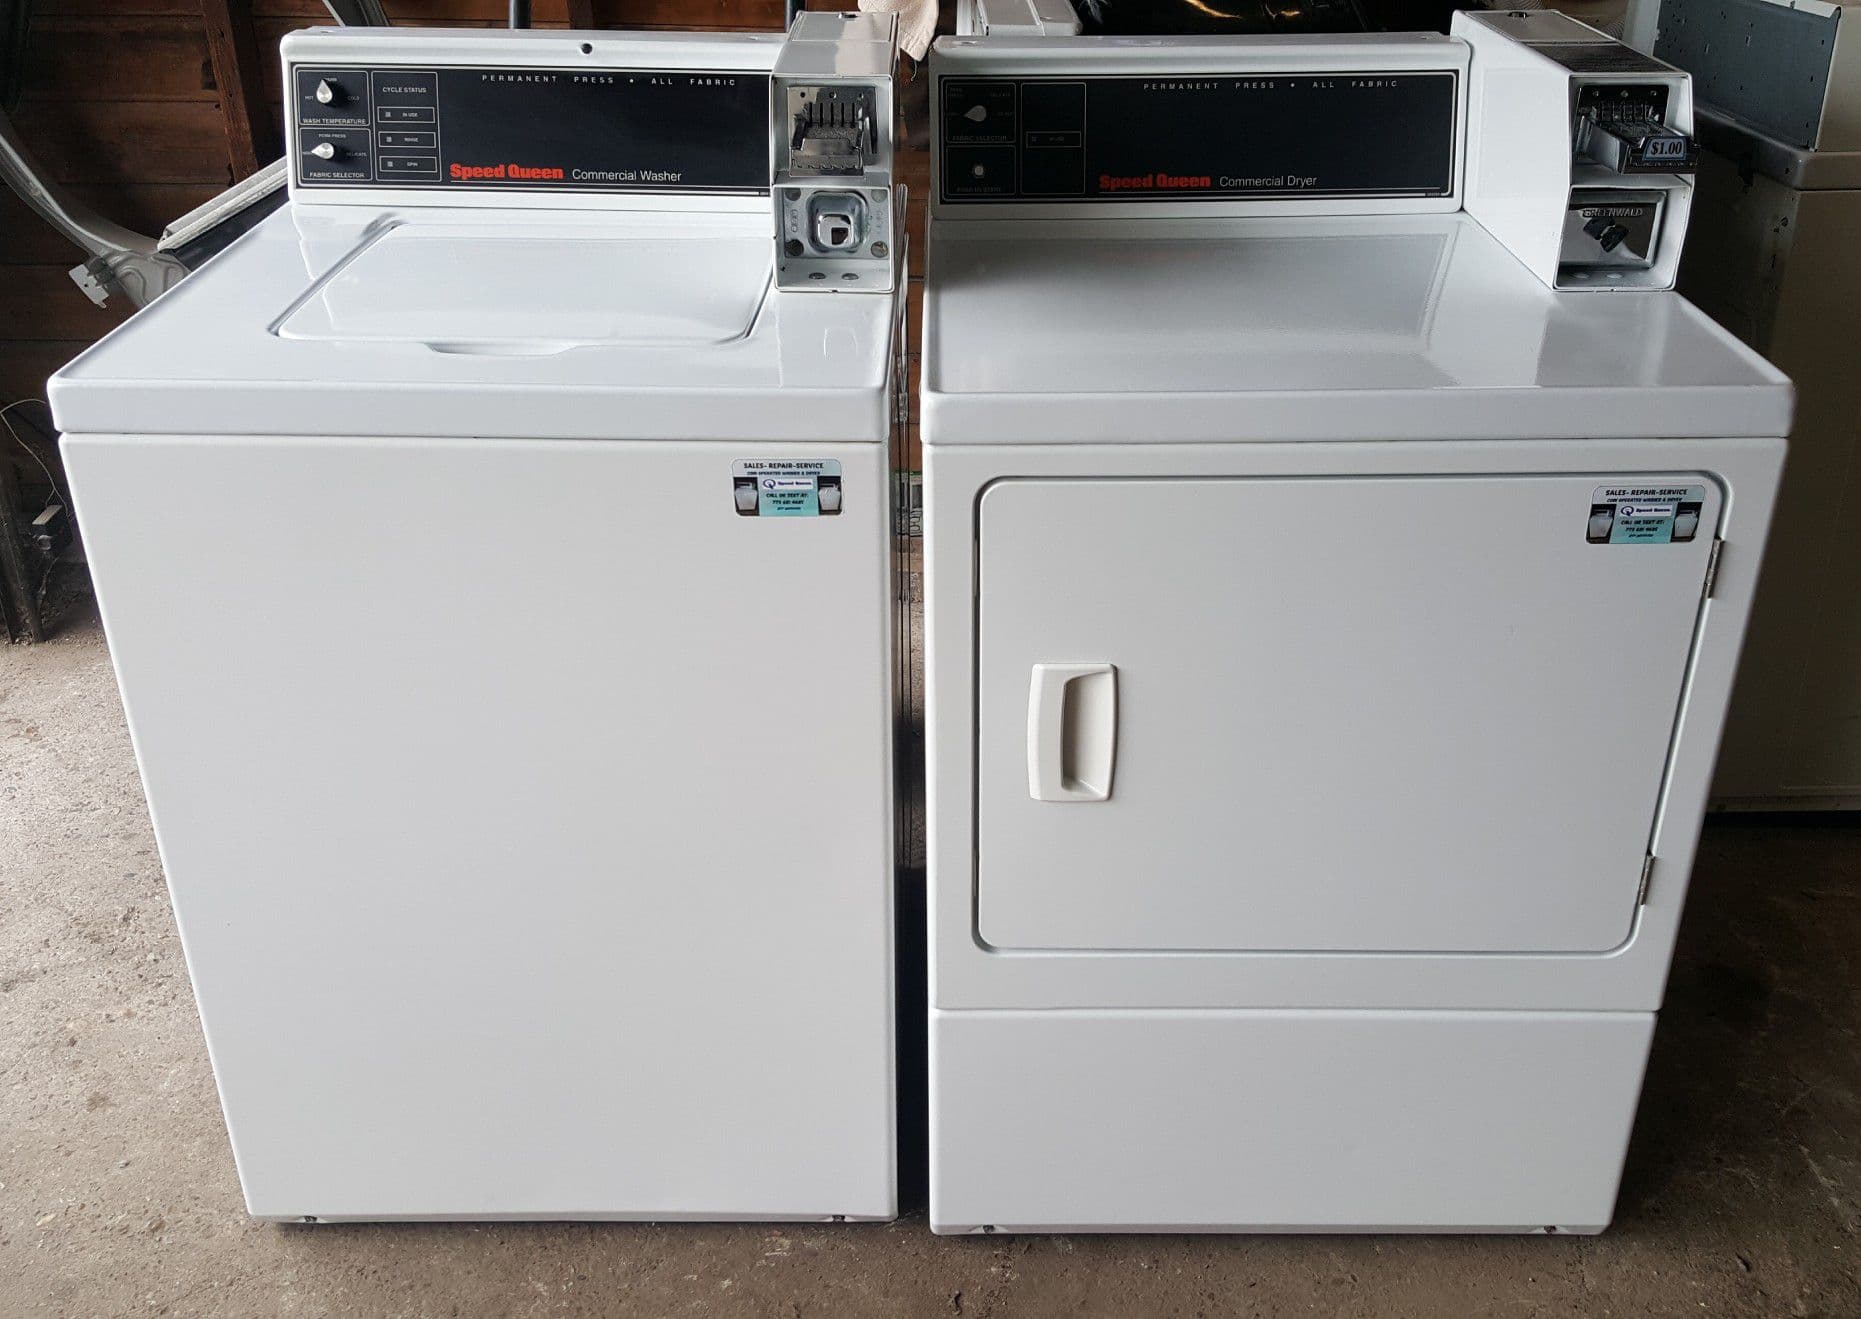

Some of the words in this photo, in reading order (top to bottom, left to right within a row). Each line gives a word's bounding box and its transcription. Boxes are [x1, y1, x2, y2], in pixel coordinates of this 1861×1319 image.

[481, 74, 558, 83] PERMANENT
[573, 76, 614, 84] PRESS
[690, 78, 736, 86] FABRIC
[1143, 82, 1219, 90] PERMANENT
[1235, 81, 1275, 89] PRESS
[1351, 80, 1398, 88] FABRIC
[1650, 140, 1682, 156] $1.00
[450, 163, 505, 180] Speed
[507, 164, 564, 179] Queen
[572, 168, 637, 181] Commercial
[641, 170, 682, 182] Washer
[1099, 174, 1153, 190] Speed
[1156, 173, 1211, 188] Queen
[1219, 175, 1284, 188] Commercial
[1287, 175, 1318, 188] Dryer
[1583, 207, 1643, 217] GREENWALD
